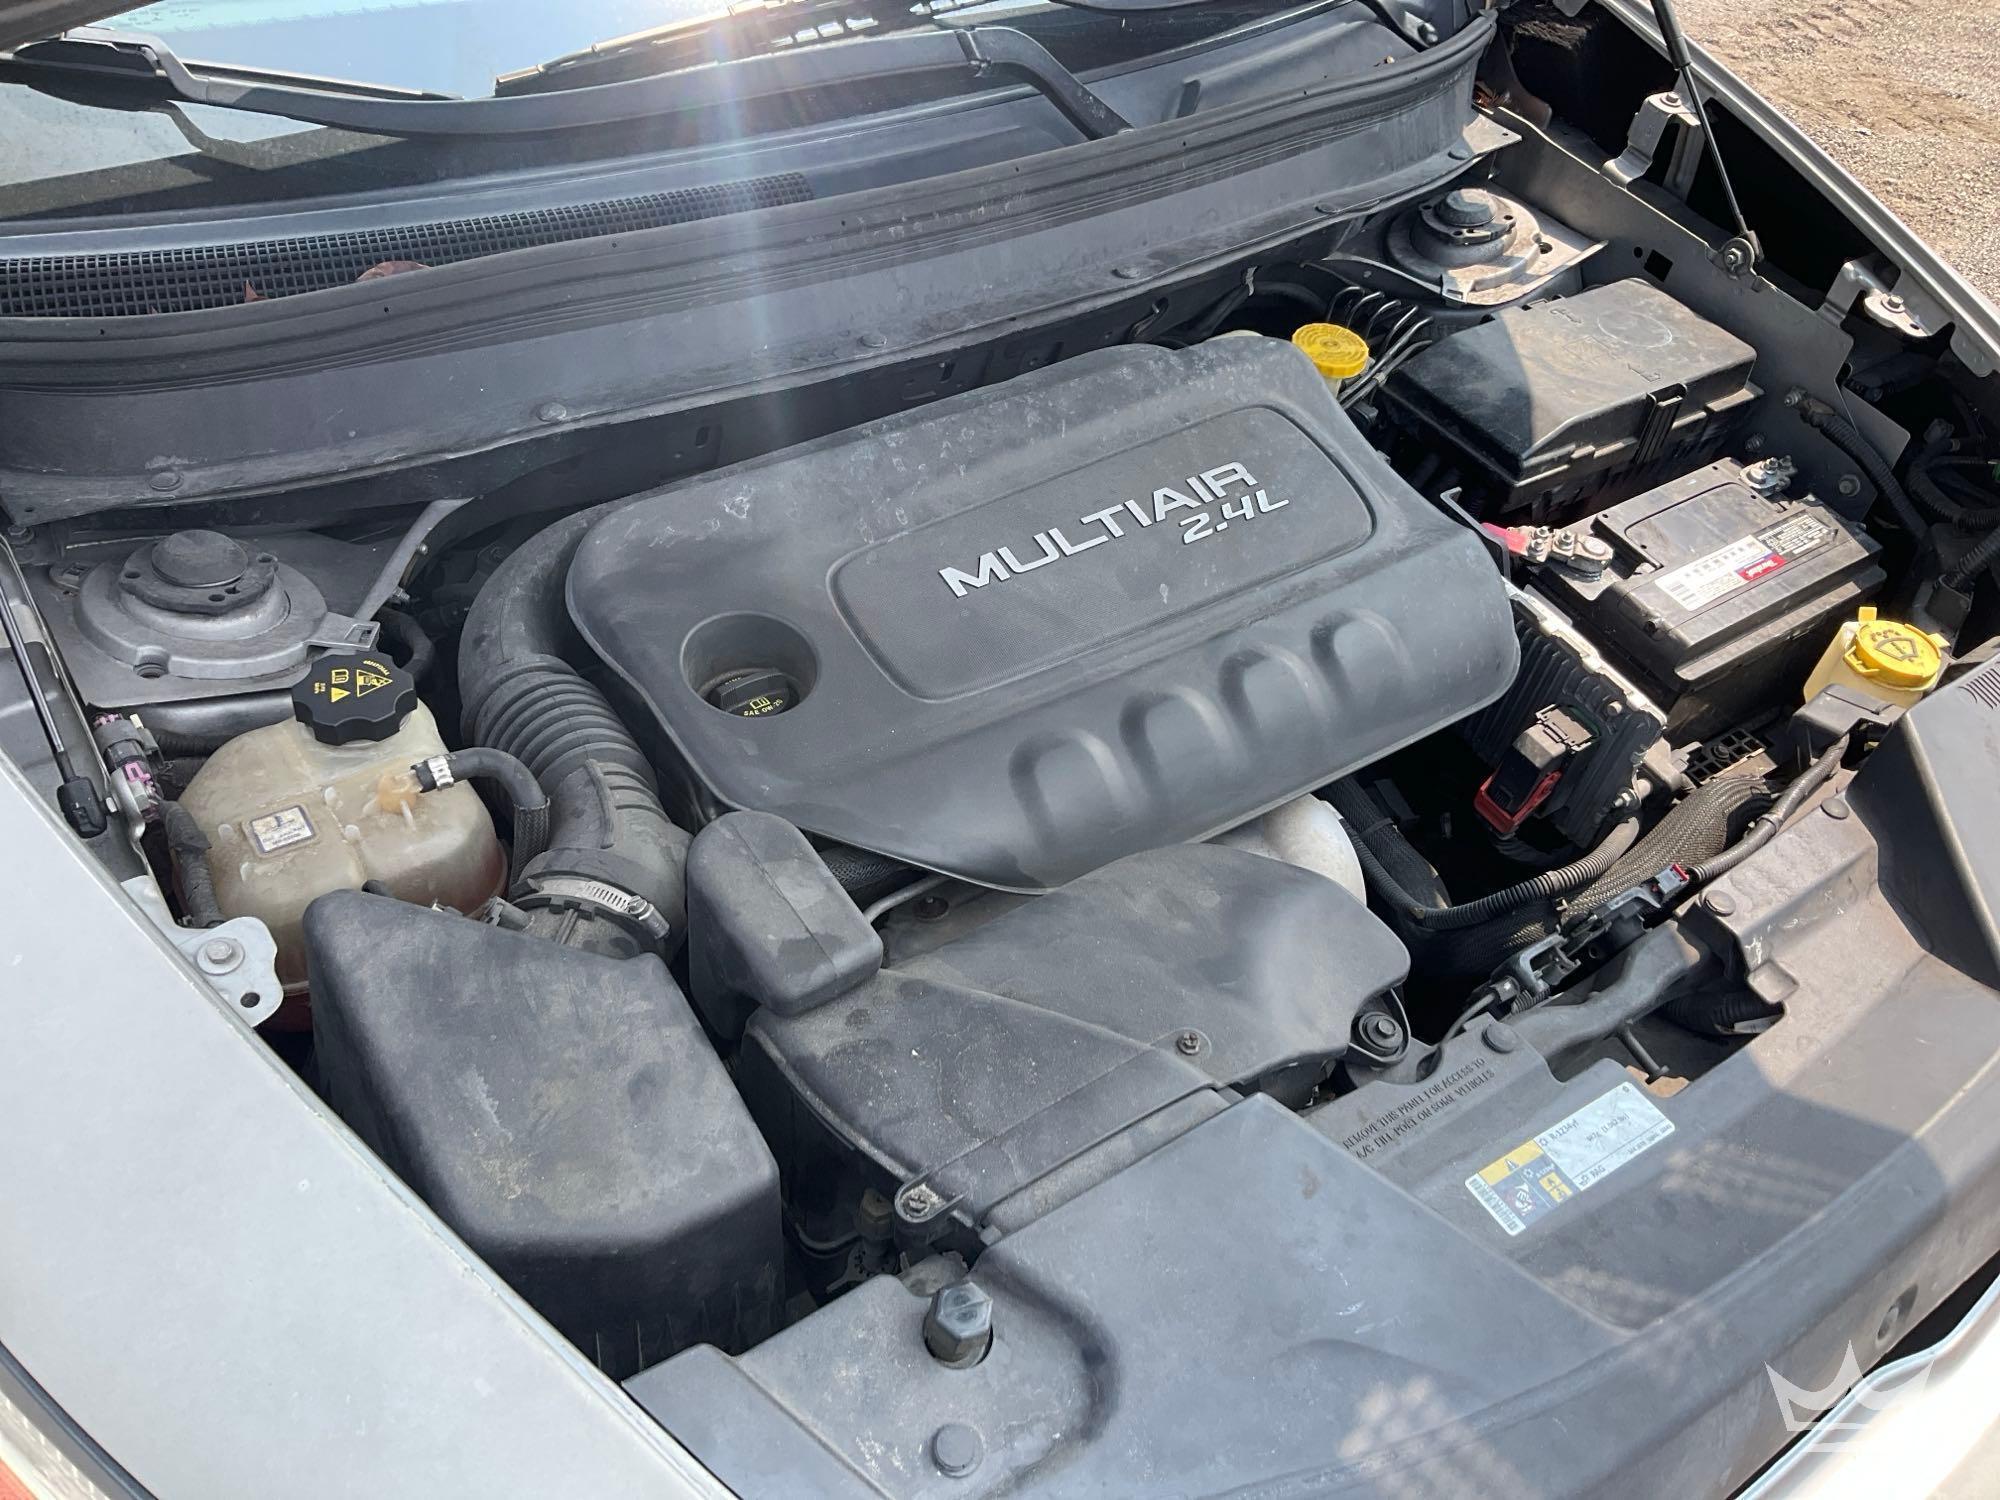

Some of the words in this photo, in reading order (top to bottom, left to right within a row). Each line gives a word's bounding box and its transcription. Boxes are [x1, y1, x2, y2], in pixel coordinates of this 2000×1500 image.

[939, 461, 1259, 598] MULTIAIR
[1178, 489, 1290, 545] 2.4L
[743, 709, 760, 717] SAE
[1342, 1123, 1379, 1150] REMOVE
[1377, 1110, 1400, 1128] THIS
[1399, 1096, 1425, 1116] PANEL
[1424, 1084, 1445, 1101] FOR
[1442, 1064, 1475, 1089] ACCESS
[1472, 1057, 1486, 1071] TO
[1355, 1142, 1375, 1159] A/C
[1374, 1132, 1394, 1149] FILL
[1393, 1118, 1418, 1137] PORT
[1417, 1108, 1433, 1122] ON
[1431, 1095, 1457, 1113] SOME
[1454, 1069, 1496, 1097] VEHICLES
